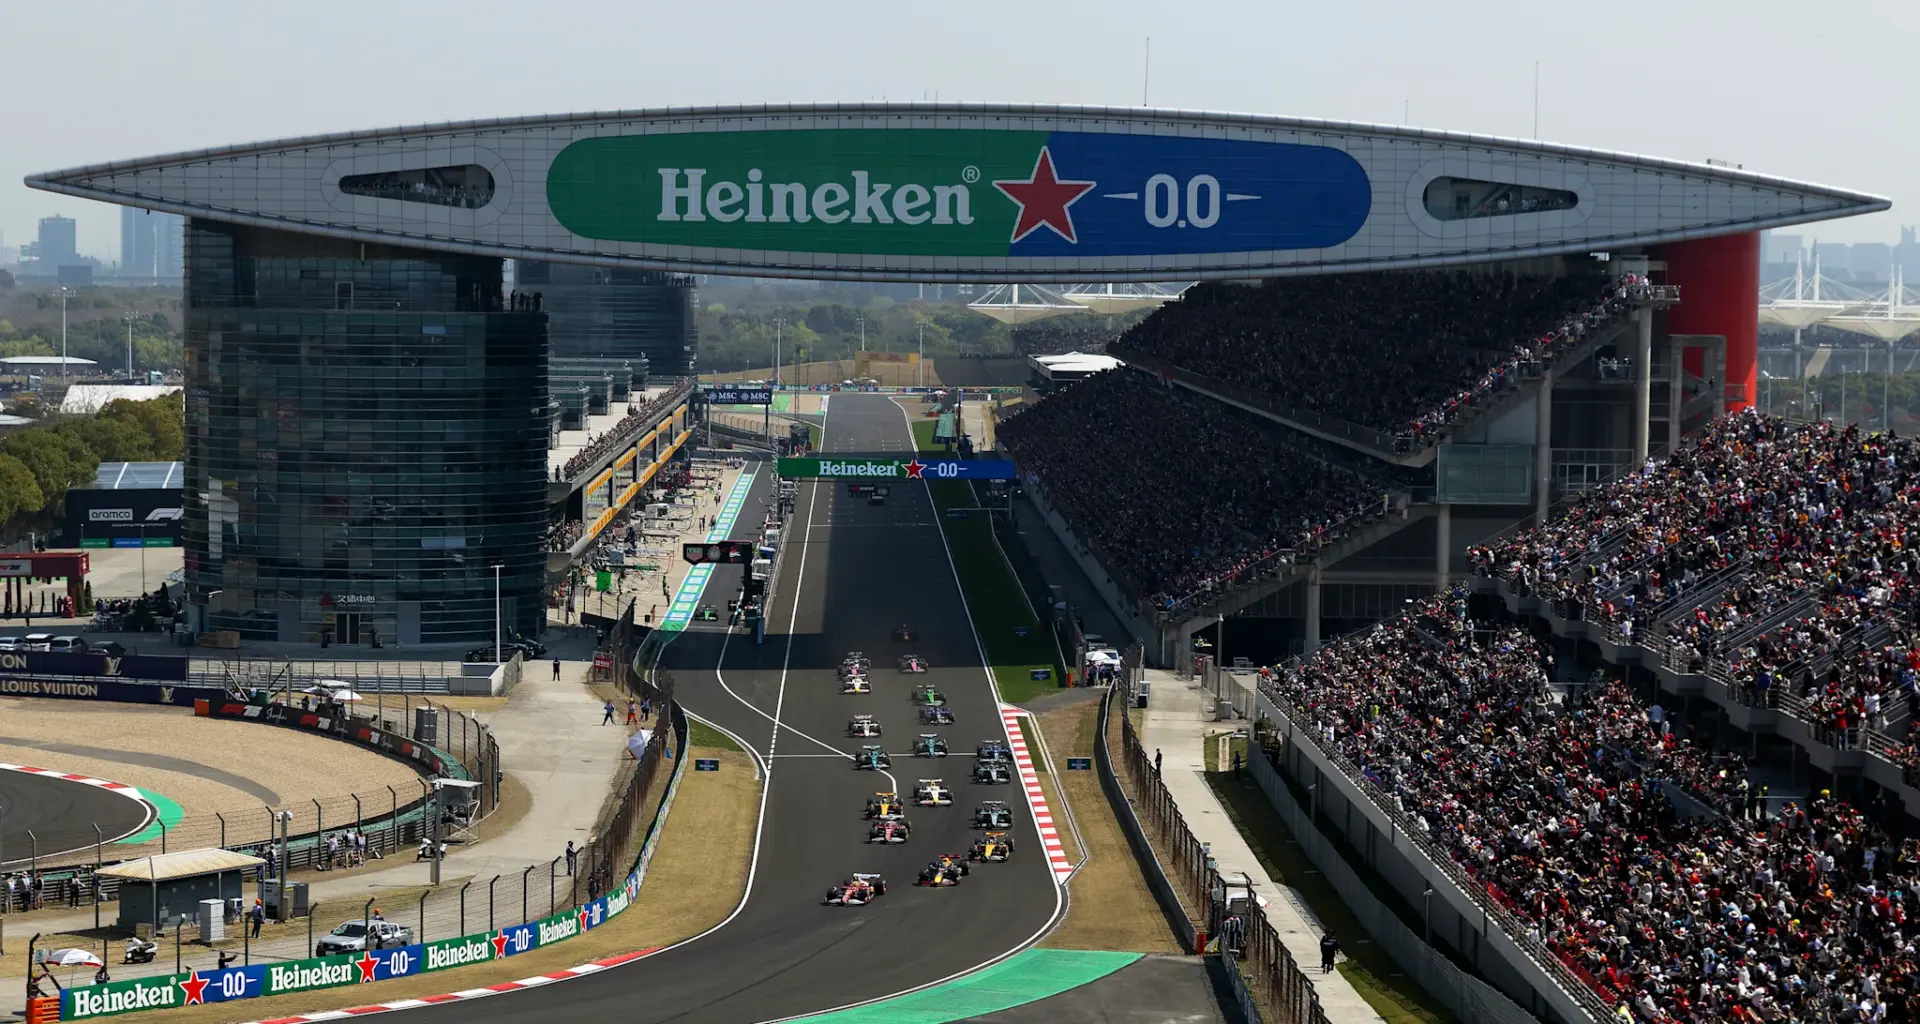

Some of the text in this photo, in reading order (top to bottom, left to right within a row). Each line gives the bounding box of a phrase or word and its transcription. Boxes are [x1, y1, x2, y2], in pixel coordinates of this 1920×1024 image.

[1144, 173, 1221, 228] 0.0
[718, 392, 737, 400] MSC
[750, 392, 769, 400] MSC
[91, 510, 131, 519] aramco
[2, 680, 98, 696] LOUIS VUITTON
